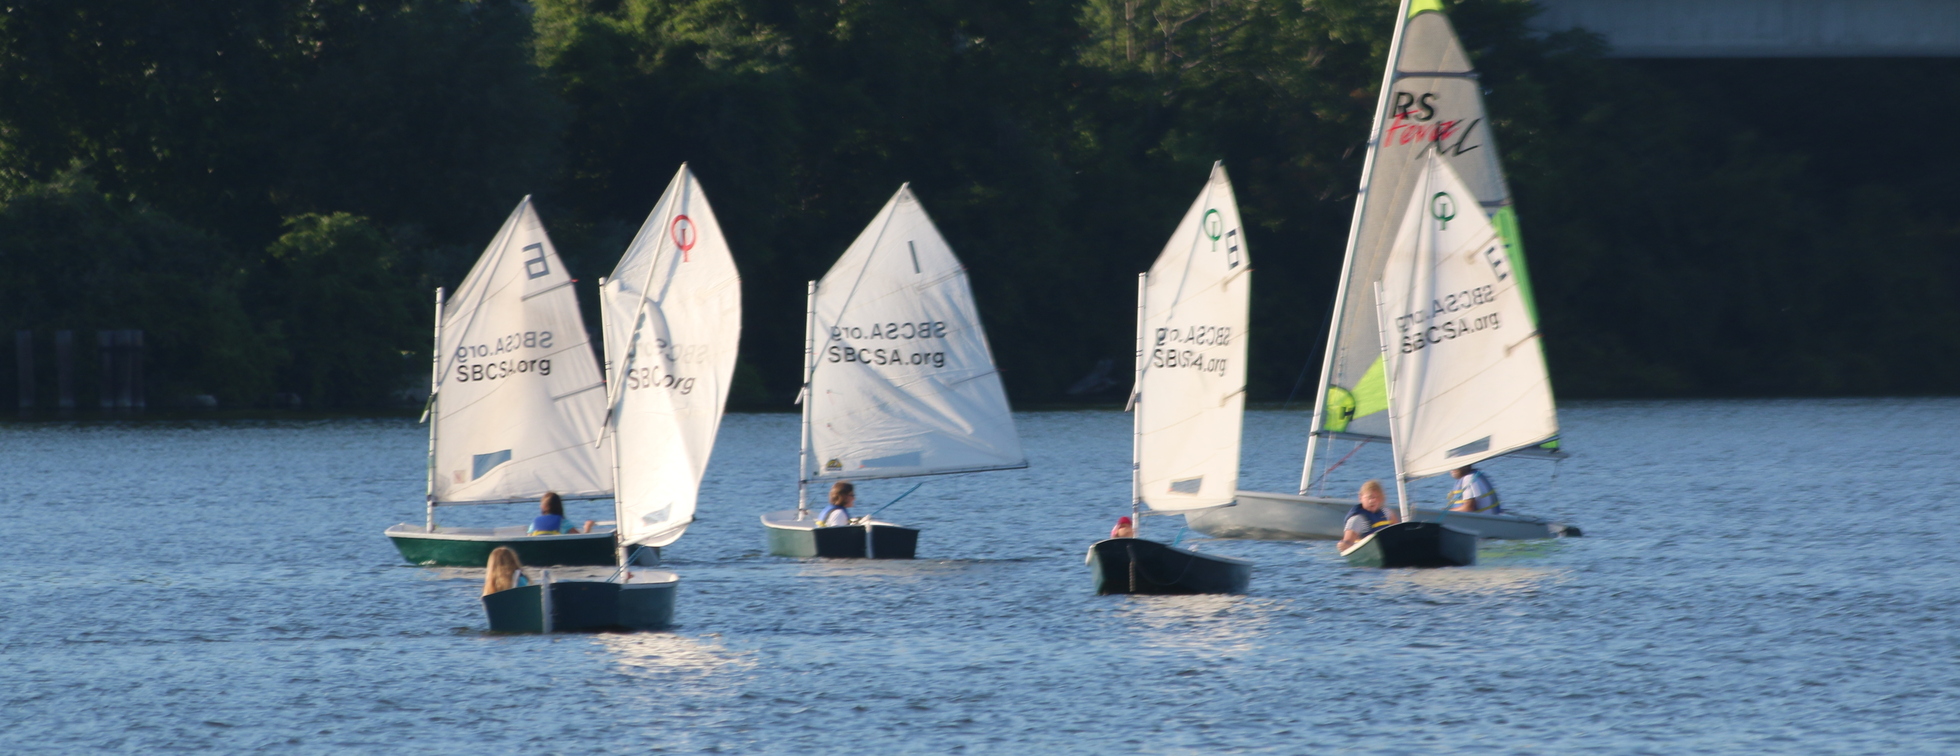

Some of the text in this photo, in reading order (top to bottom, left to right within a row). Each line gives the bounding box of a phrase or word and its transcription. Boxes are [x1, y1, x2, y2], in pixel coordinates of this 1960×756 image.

[1389, 91, 1438, 121] RS
[1401, 312, 1500, 354] SBCSA.org
[828, 346, 945, 368] SBCSA.org
[456, 359, 551, 383] SBCSA.org
